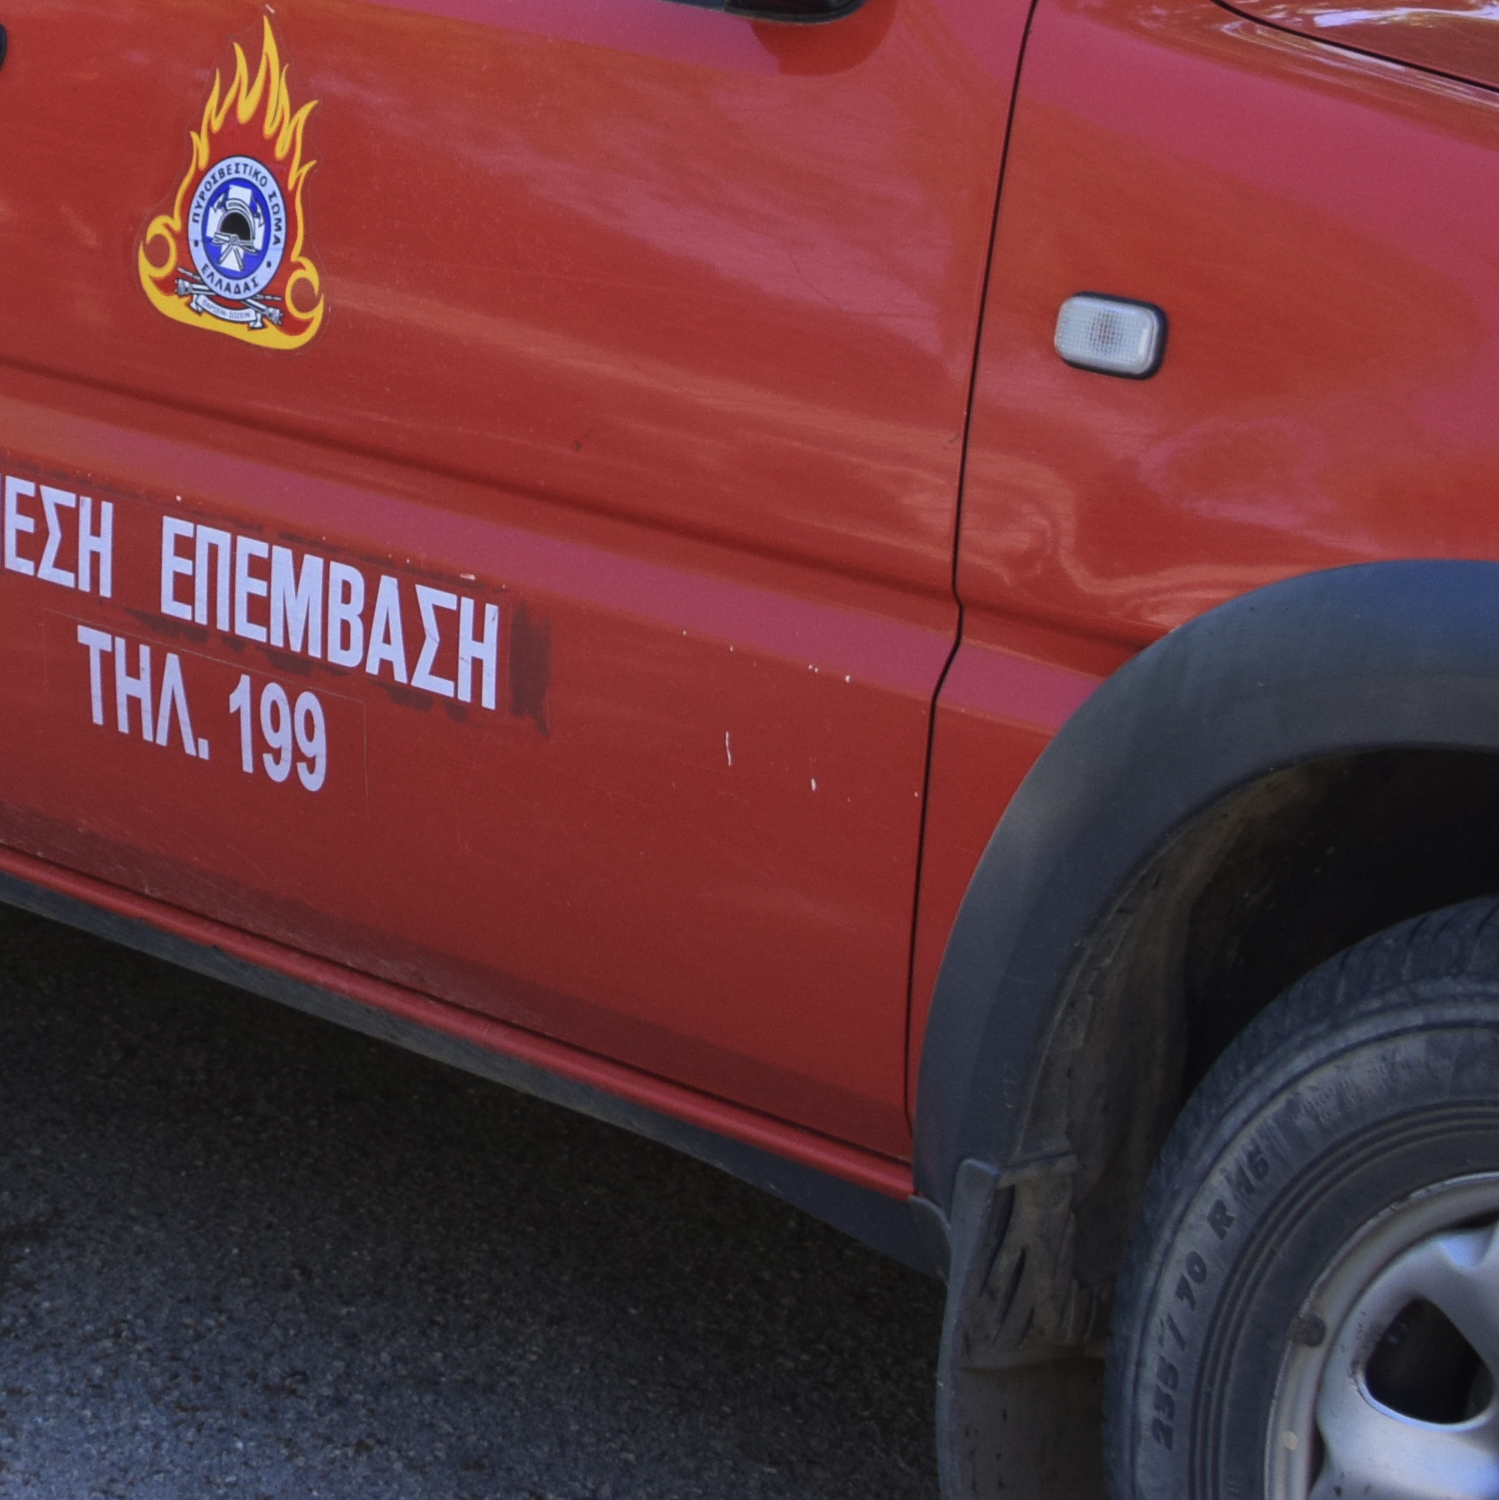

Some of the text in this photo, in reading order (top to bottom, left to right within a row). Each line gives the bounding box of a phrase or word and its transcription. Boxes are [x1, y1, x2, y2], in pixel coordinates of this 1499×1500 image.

[191, 162, 283, 246] ΠΥΡΟΣΒΕΣΤΙΚΟ ΣΩΜΑ
[201, 263, 259, 295] ΕΛΛΑΔΑΣ
[160, 515, 499, 710] ΕΠΕΜΒΑΣΗ
[77, 626, 328, 792] ΤΗΛ. 199
